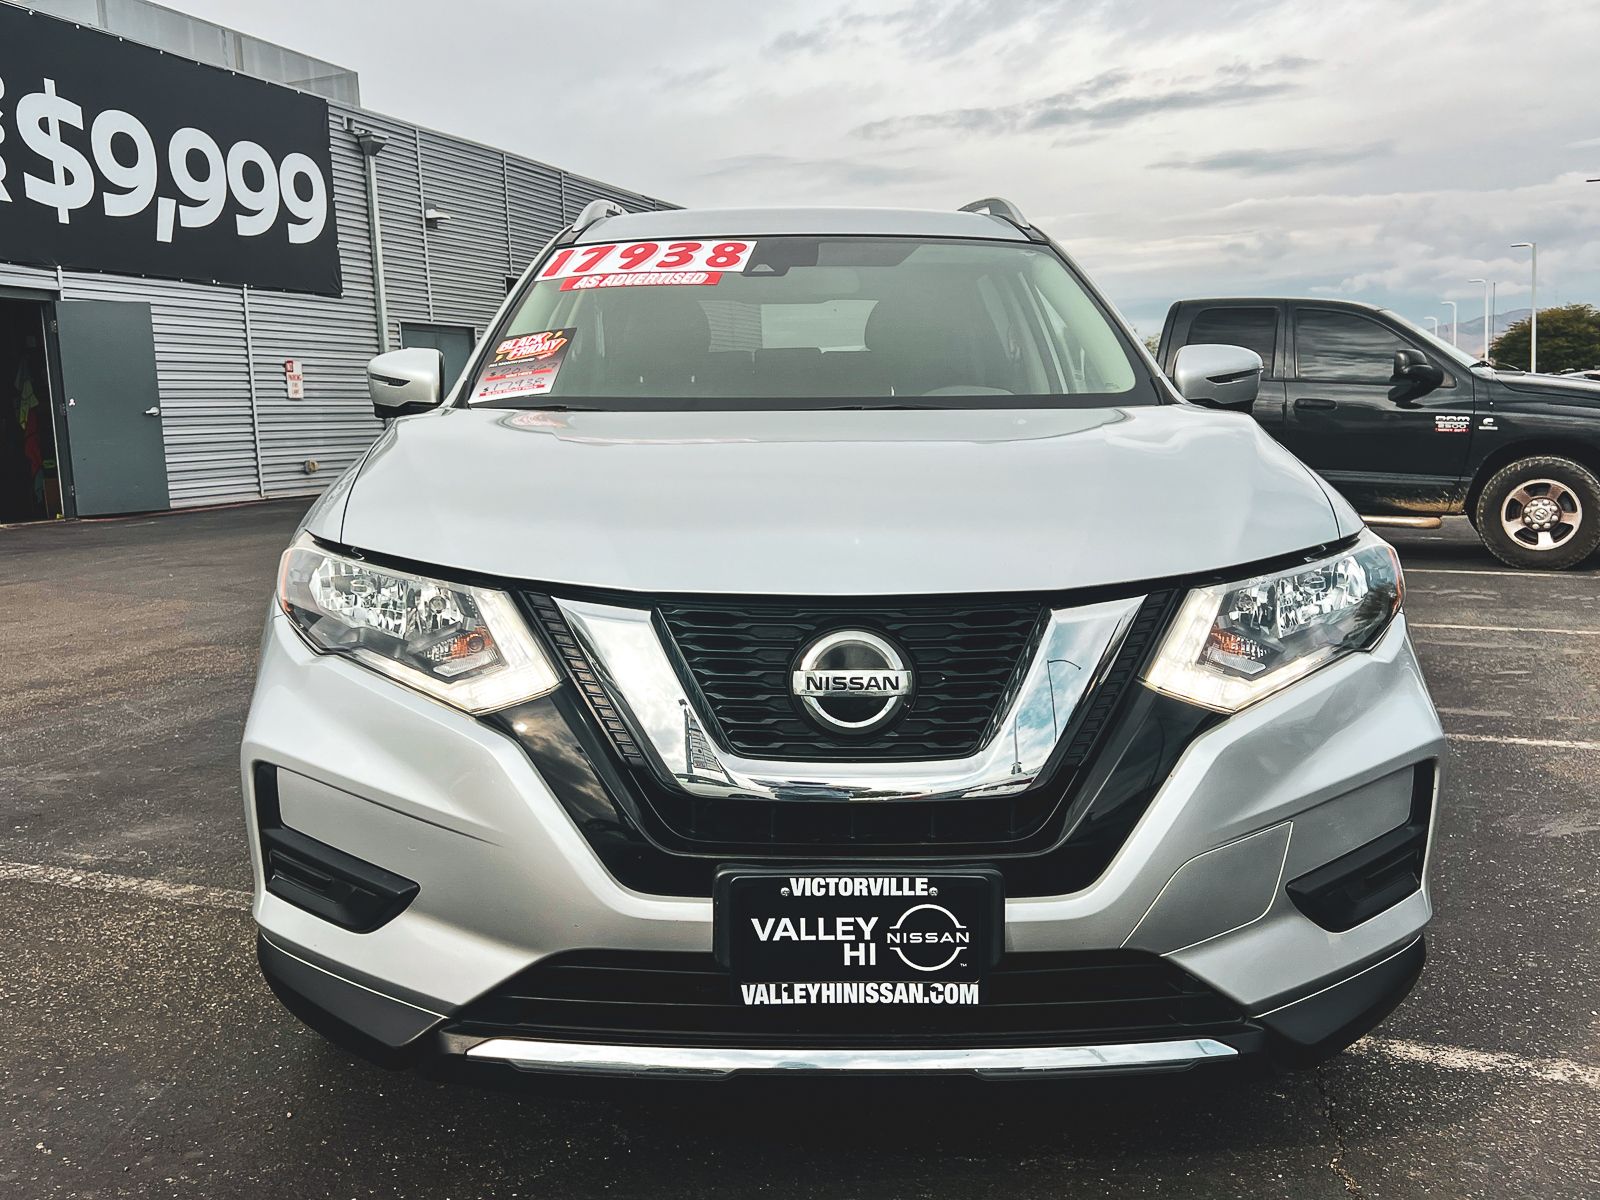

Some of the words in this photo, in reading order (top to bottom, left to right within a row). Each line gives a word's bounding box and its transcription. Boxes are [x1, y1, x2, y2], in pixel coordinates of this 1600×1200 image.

[16, 78, 327, 243] $9,999
[542, 242, 748, 278] 17938
[572, 275, 602, 290] AS
[600, 271, 709, 288] ADVERTISED
[499, 332, 548, 350] BLACK
[509, 339, 561, 357] FRIDAY
[806, 676, 900, 691] NISSAN
[789, 877, 929, 897] VICTORVILLE
[750, 916, 879, 942] VALLEY
[886, 931, 970, 944] NISSAN
[843, 942, 877, 966] HI
[740, 982, 979, 1006] VALLEYHINISSAN.COM
